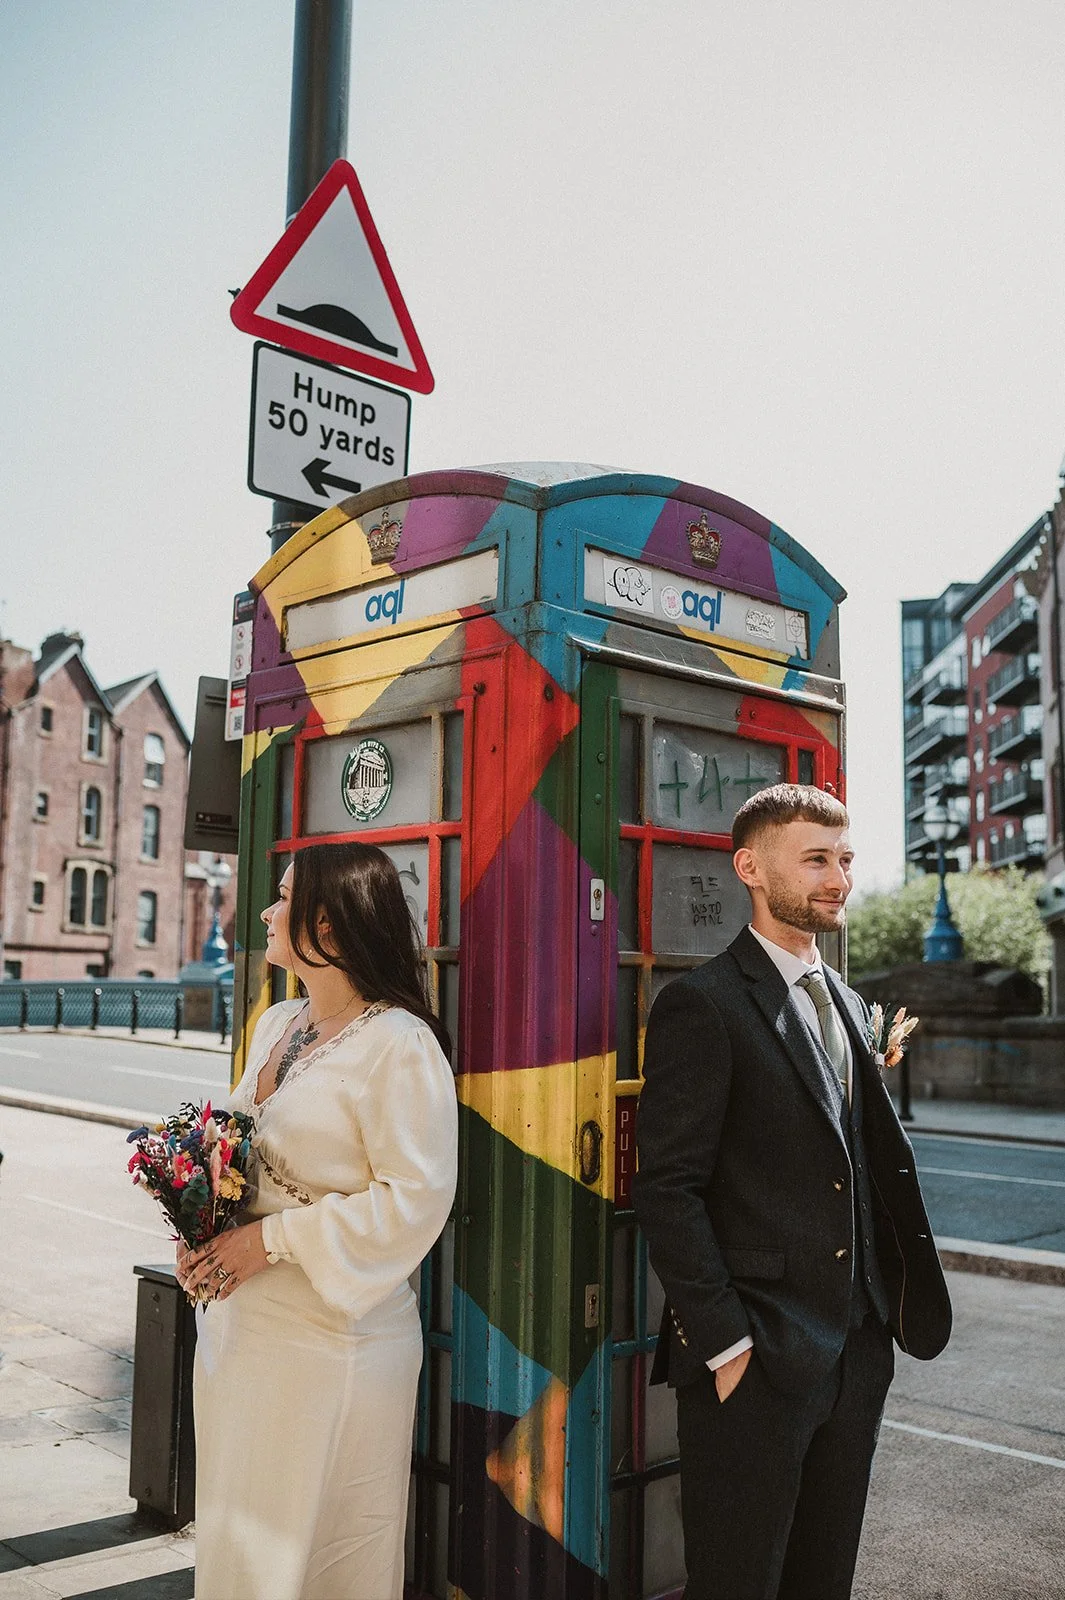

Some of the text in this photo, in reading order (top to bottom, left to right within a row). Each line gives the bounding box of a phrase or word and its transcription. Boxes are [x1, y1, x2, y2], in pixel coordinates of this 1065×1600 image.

[293, 372, 376, 426] Hump
[268, 401, 395, 466] 50 yards
[365, 578, 405, 625] aql
[681, 590, 722, 632] aql
[620, 1111, 629, 1196] PULL
